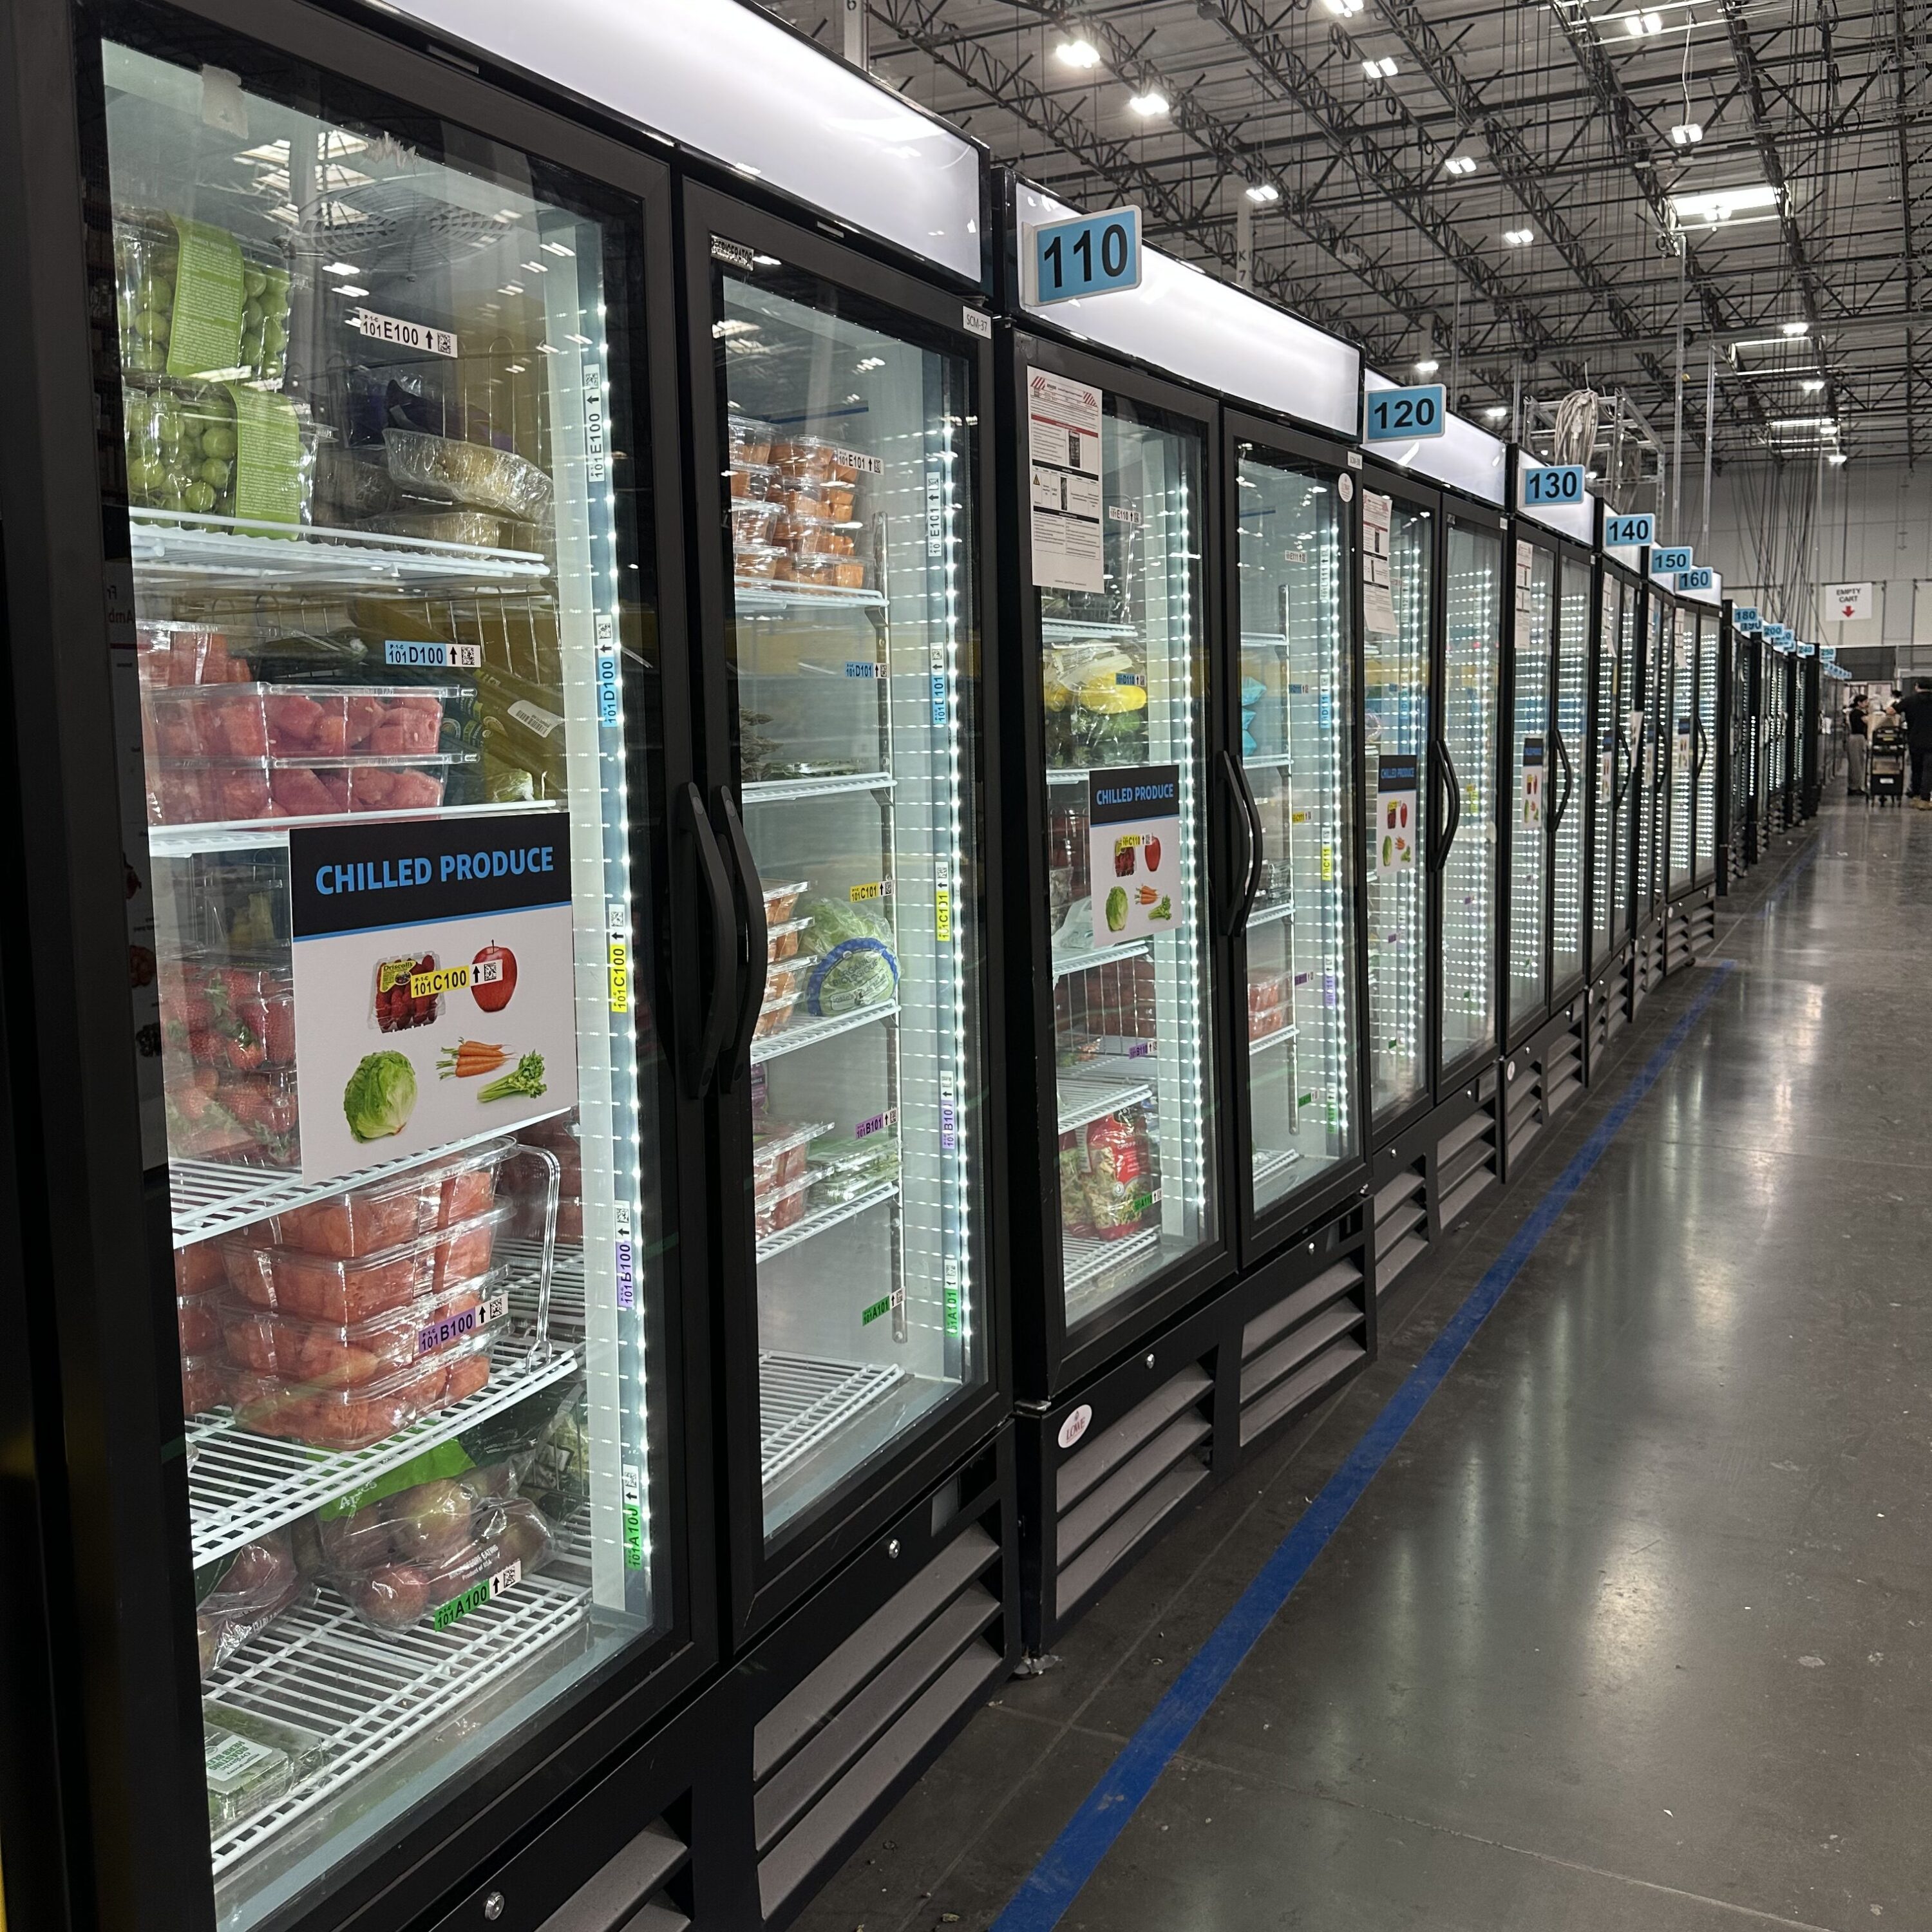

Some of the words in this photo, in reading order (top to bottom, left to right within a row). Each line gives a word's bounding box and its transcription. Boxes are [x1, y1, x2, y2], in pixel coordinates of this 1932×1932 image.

[1044, 224, 1128, 288] 110
[1238, 250, 1246, 261] K
[1238, 270, 1246, 281] 7
[967, 314, 987, 332] SCM-37
[1374, 398, 1434, 429] 120
[1530, 471, 1577, 498] 130
[1609, 519, 1649, 541] 140
[1655, 553, 1686, 568] 150
[1682, 571, 1709, 587] 160
[1836, 587, 1861, 596] EMPTY
[1735, 611, 1756, 620] 180
[1764, 627, 1782, 636] 200
[1096, 788, 1133, 805] CHILLED
[1135, 783, 1174, 801] PRODUCE
[316, 857, 432, 895] CHILLED
[440, 846, 554, 882] PRODUCE
[222, 1740, 246, 1756] HERB
[206, 1754, 225, 1766] BLE
[207, 1745, 250, 1770] ROASTING
[220, 1751, 251, 1771] Organic
